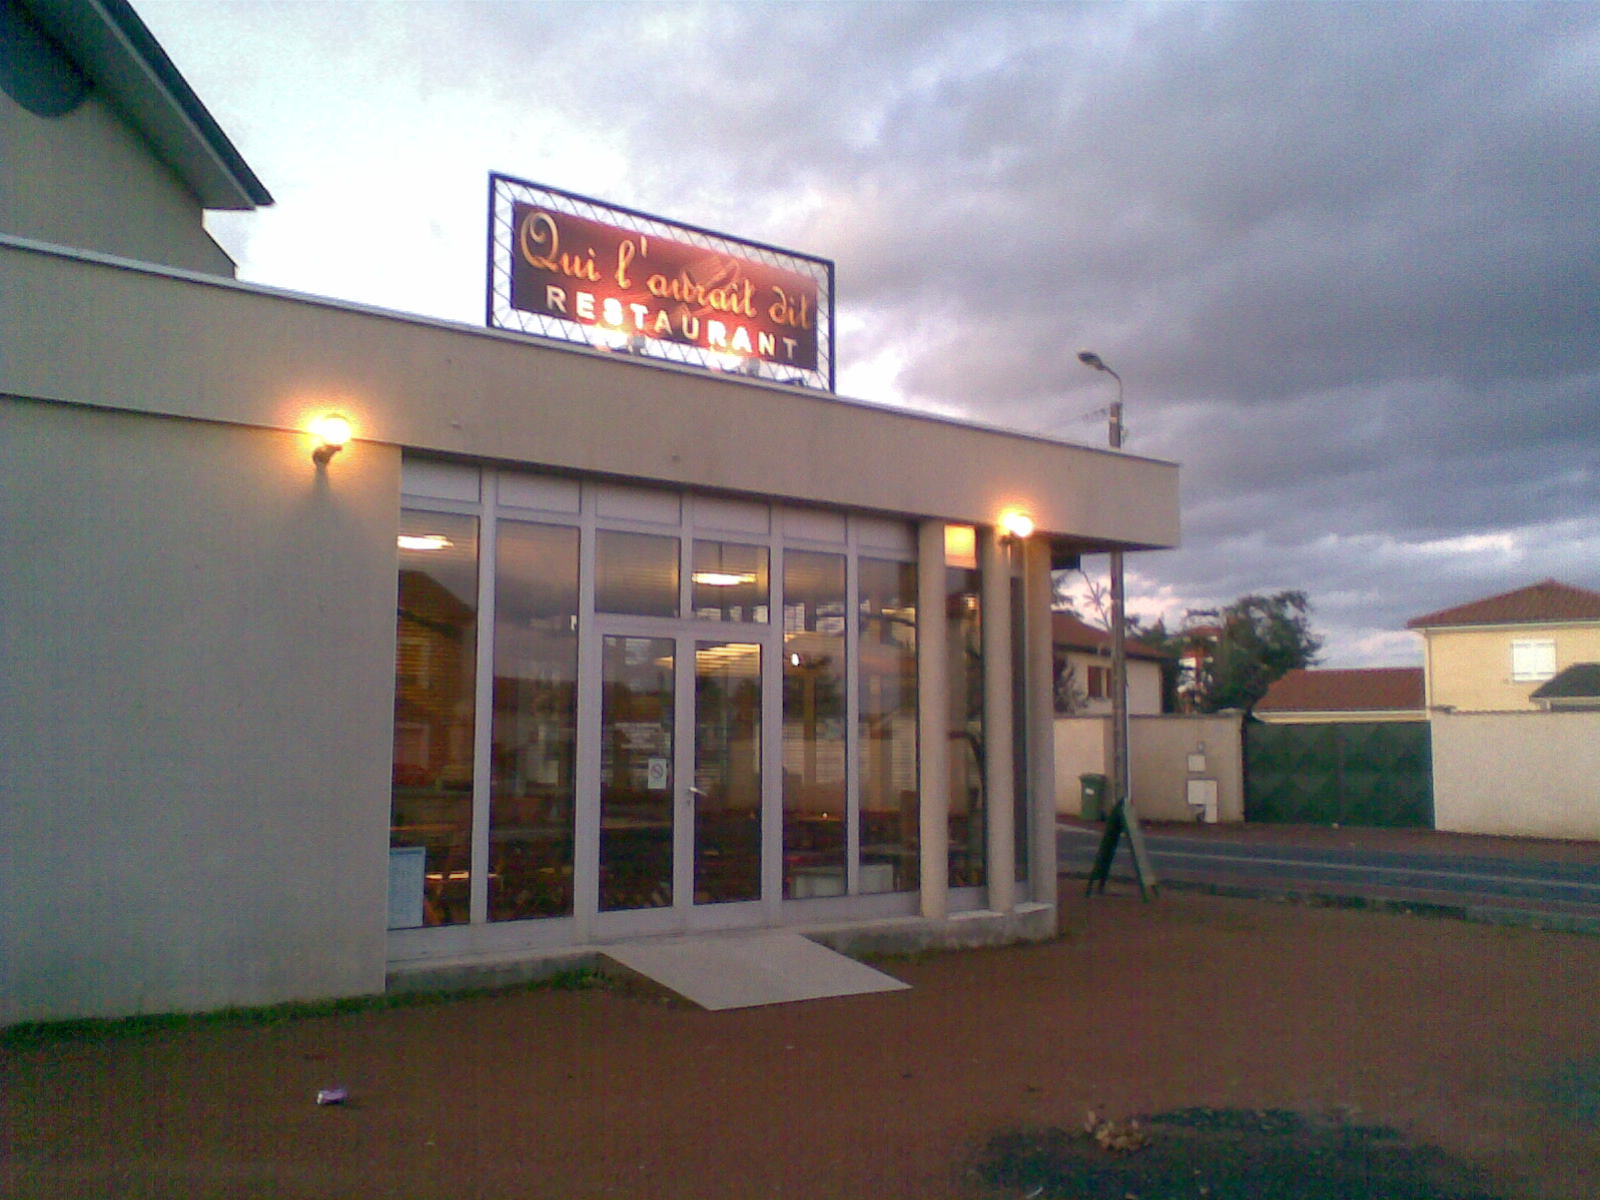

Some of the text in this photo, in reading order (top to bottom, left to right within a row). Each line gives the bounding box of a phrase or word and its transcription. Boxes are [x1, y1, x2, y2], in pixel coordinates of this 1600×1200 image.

[520, 211, 601, 282] Qui
[769, 286, 809, 329] dit
[546, 285, 799, 360] RESTAURANT
